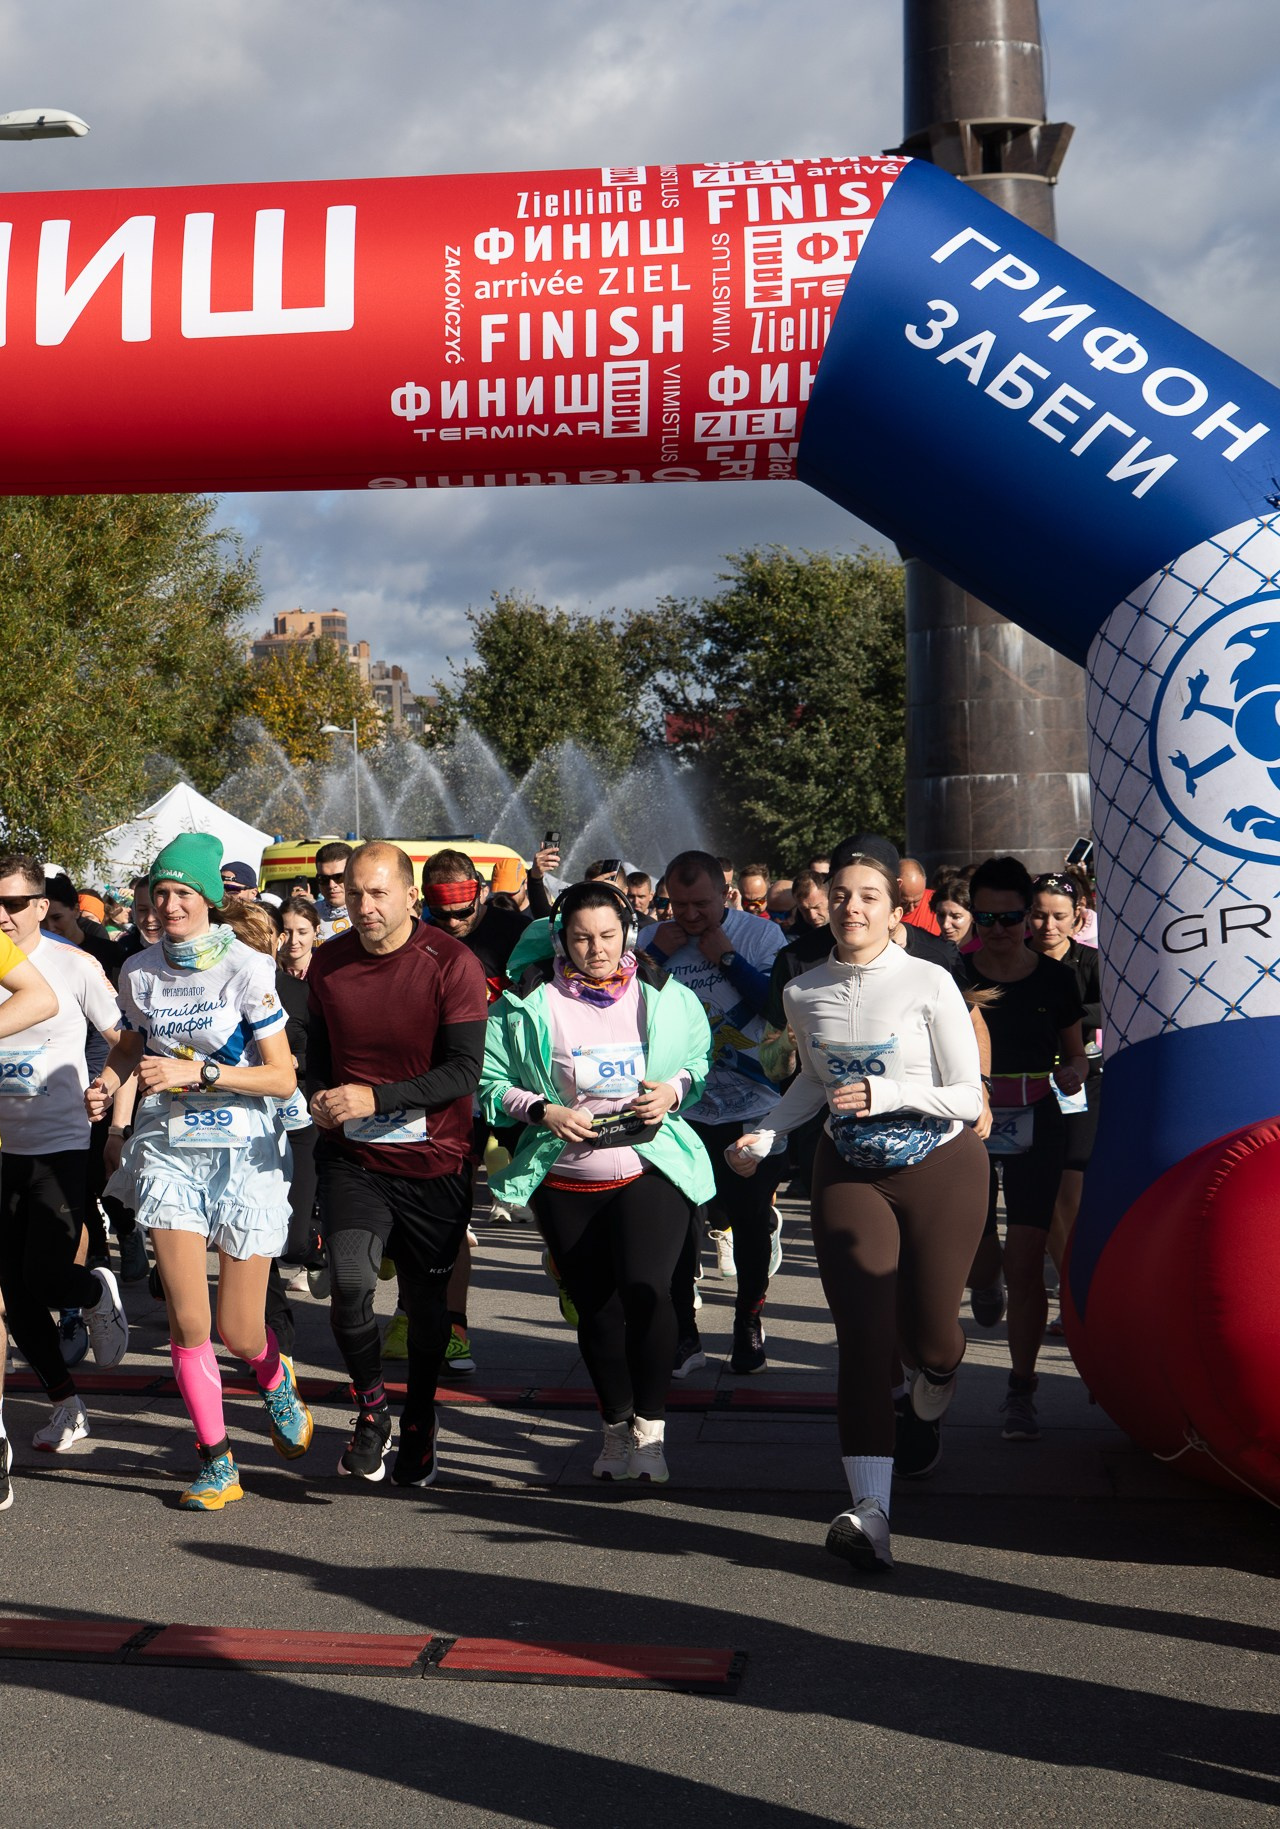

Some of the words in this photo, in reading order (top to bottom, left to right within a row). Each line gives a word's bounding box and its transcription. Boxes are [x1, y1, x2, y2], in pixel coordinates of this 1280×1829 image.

[699, 168, 792, 184] ZIEL
[807, 163, 904, 176] arrivé
[516, 187, 642, 219] Ziellinie
[473, 217, 684, 265] ФИНИШ
[474, 269, 583, 300] arrivée
[598, 263, 691, 296] ZIEL
[752, 230, 783, 303] MAALI
[444, 245, 465, 364] ZAKOŃCZYĆ
[711, 232, 731, 353] VIIMISTLUS
[480, 303, 684, 363] FINISH
[930, 226, 1271, 462] ГРИФОН
[390, 373, 598, 421] ФИНИШ
[611, 367, 641, 435] MAALI
[660, 363, 681, 463] VIIMISTLUS
[904, 299, 1179, 499] ЗАБЕГИ
[413, 421, 601, 442] TERMINAR
[701, 412, 793, 438] ZIEL
[599, 1060, 635, 1078] 611
[827, 1058, 886, 1076] 340
[184, 1109, 233, 1126] 539
[276, 1105, 299, 1118] 46
